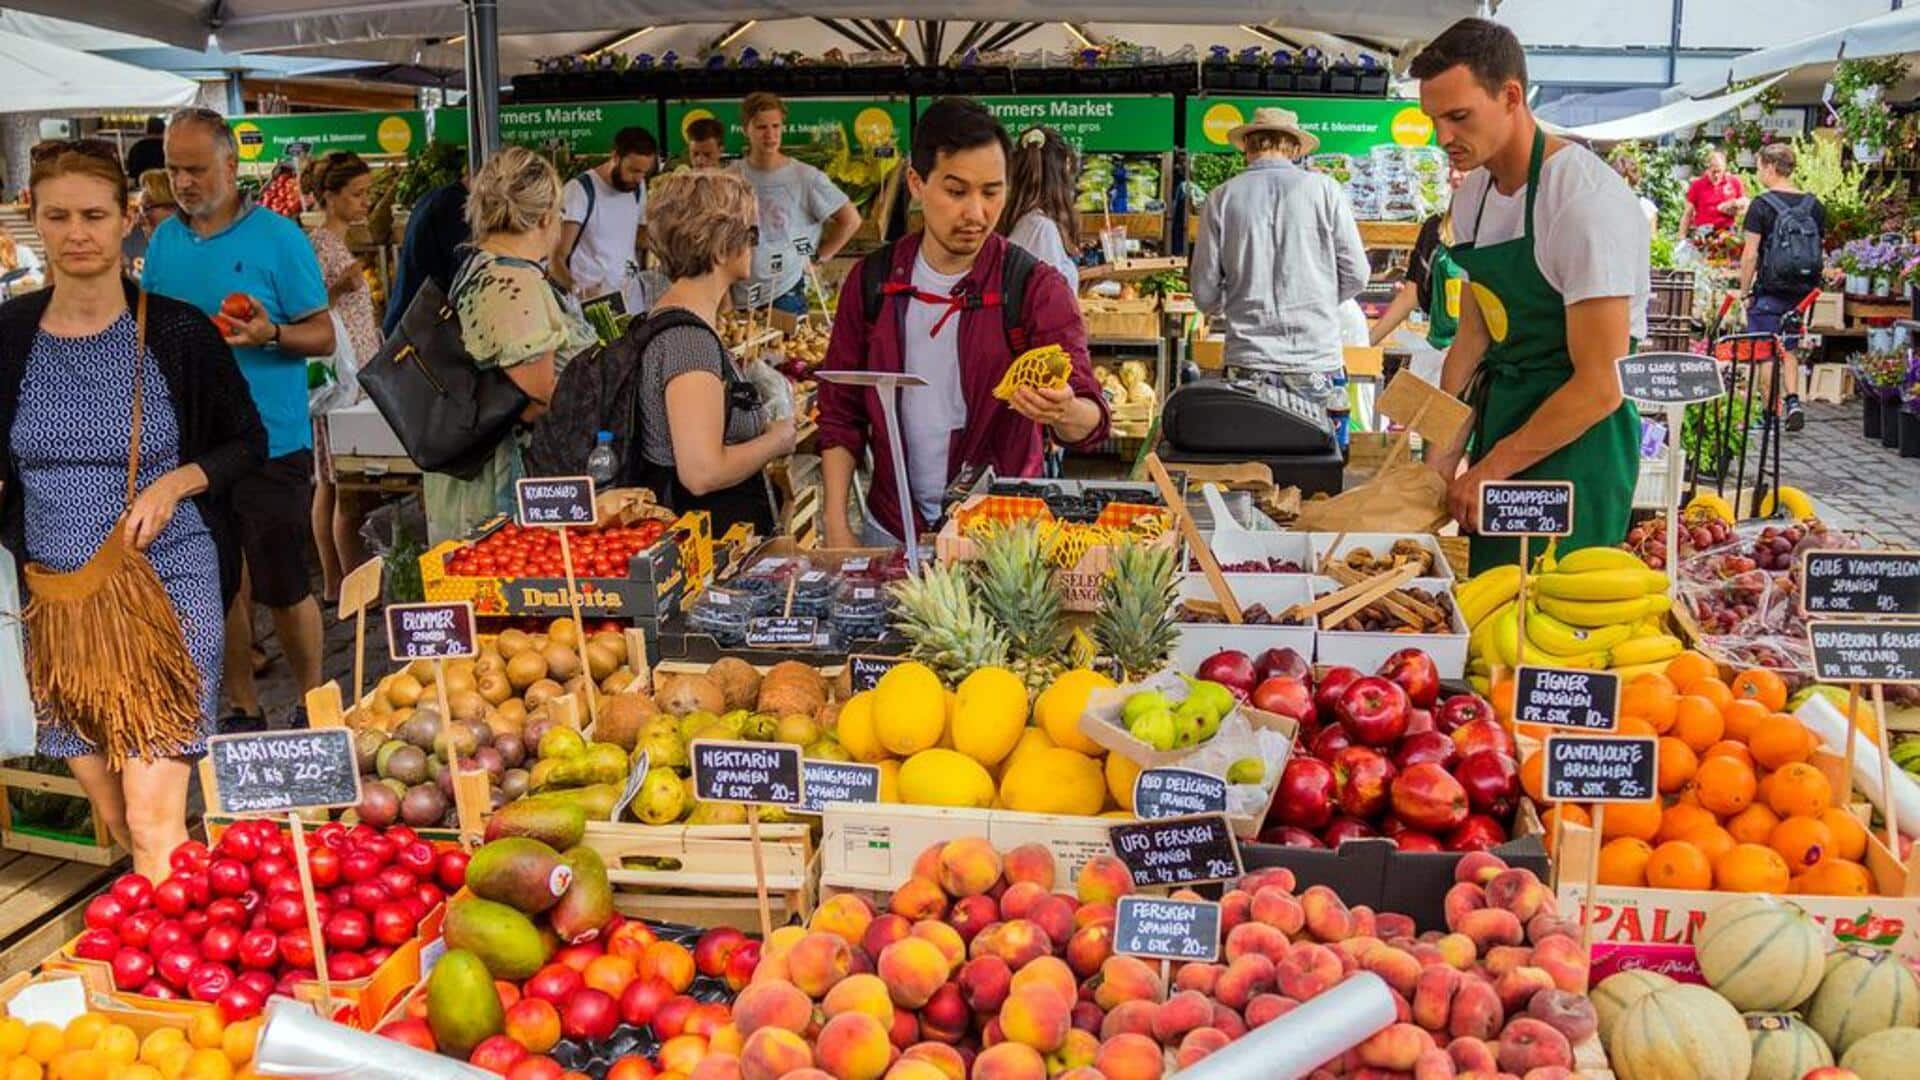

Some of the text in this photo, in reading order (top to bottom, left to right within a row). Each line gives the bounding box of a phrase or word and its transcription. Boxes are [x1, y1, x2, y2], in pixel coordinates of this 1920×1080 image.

[500, 107, 603, 124] rmers Market
[983, 101, 1114, 117] armers Market
[1491, 519, 1501, 531] 6
[407, 642, 417, 657] 8
[711, 783, 722, 797] 4
[1151, 803, 1160, 817] 3
[1121, 825, 1214, 852] UFO FERSKEN
[1132, 901, 1196, 920] FERSKEN
[1131, 936, 1141, 951] 6
